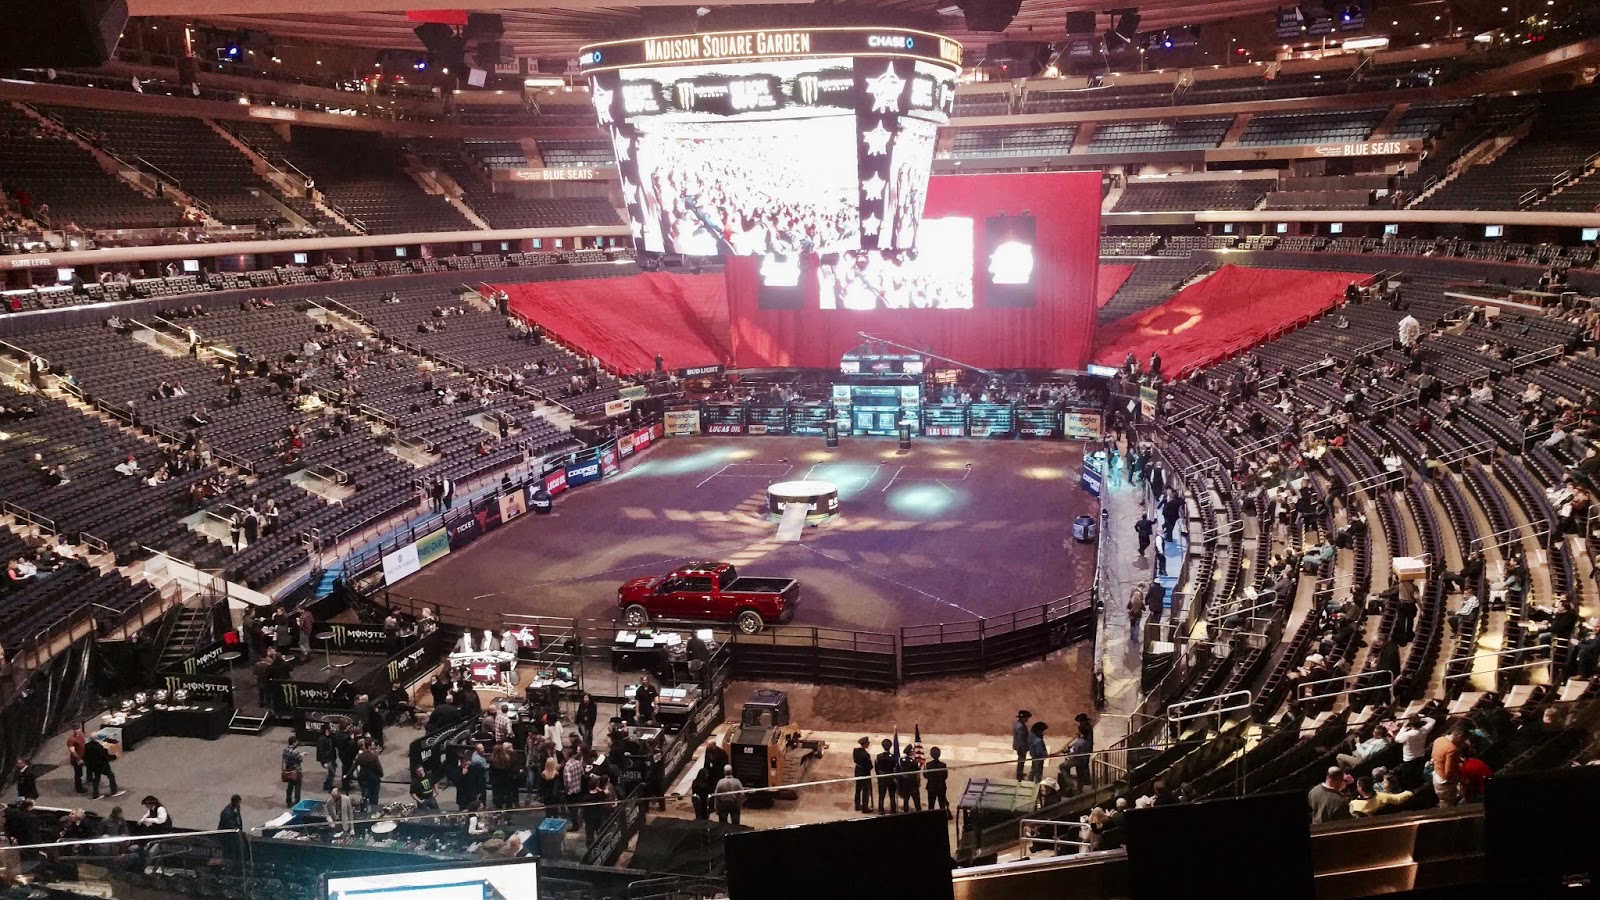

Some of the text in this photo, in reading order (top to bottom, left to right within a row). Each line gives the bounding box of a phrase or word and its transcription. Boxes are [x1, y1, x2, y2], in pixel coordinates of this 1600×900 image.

[645, 32, 810, 61] MADISON SQUARE GARDEN
[868, 35, 906, 48] CHASE
[1344, 143, 1369, 156] BLUE
[1371, 142, 1401, 155] SEATS
[543, 170, 565, 180] BLUE
[567, 169, 593, 180] SEATS
[11, 258, 51, 267] SUITE LEVEL
[687, 366, 719, 376] BUD LIGHT
[667, 412, 697, 421] Wrangler
[1068, 415, 1098, 425] Wrangler
[667, 422, 697, 430] Wrangler
[709, 425, 741, 433] LUCAS OIL
[1068, 424, 1098, 433] Wrangler
[929, 428, 960, 436] LAS VEGAS
[567, 464, 598, 478] COOPER
[457, 519, 475, 534] TICKET
[196, 646, 223, 666] MONST
[183, 681, 230, 693] MONSTER
[743, 746, 754, 754] CAT
